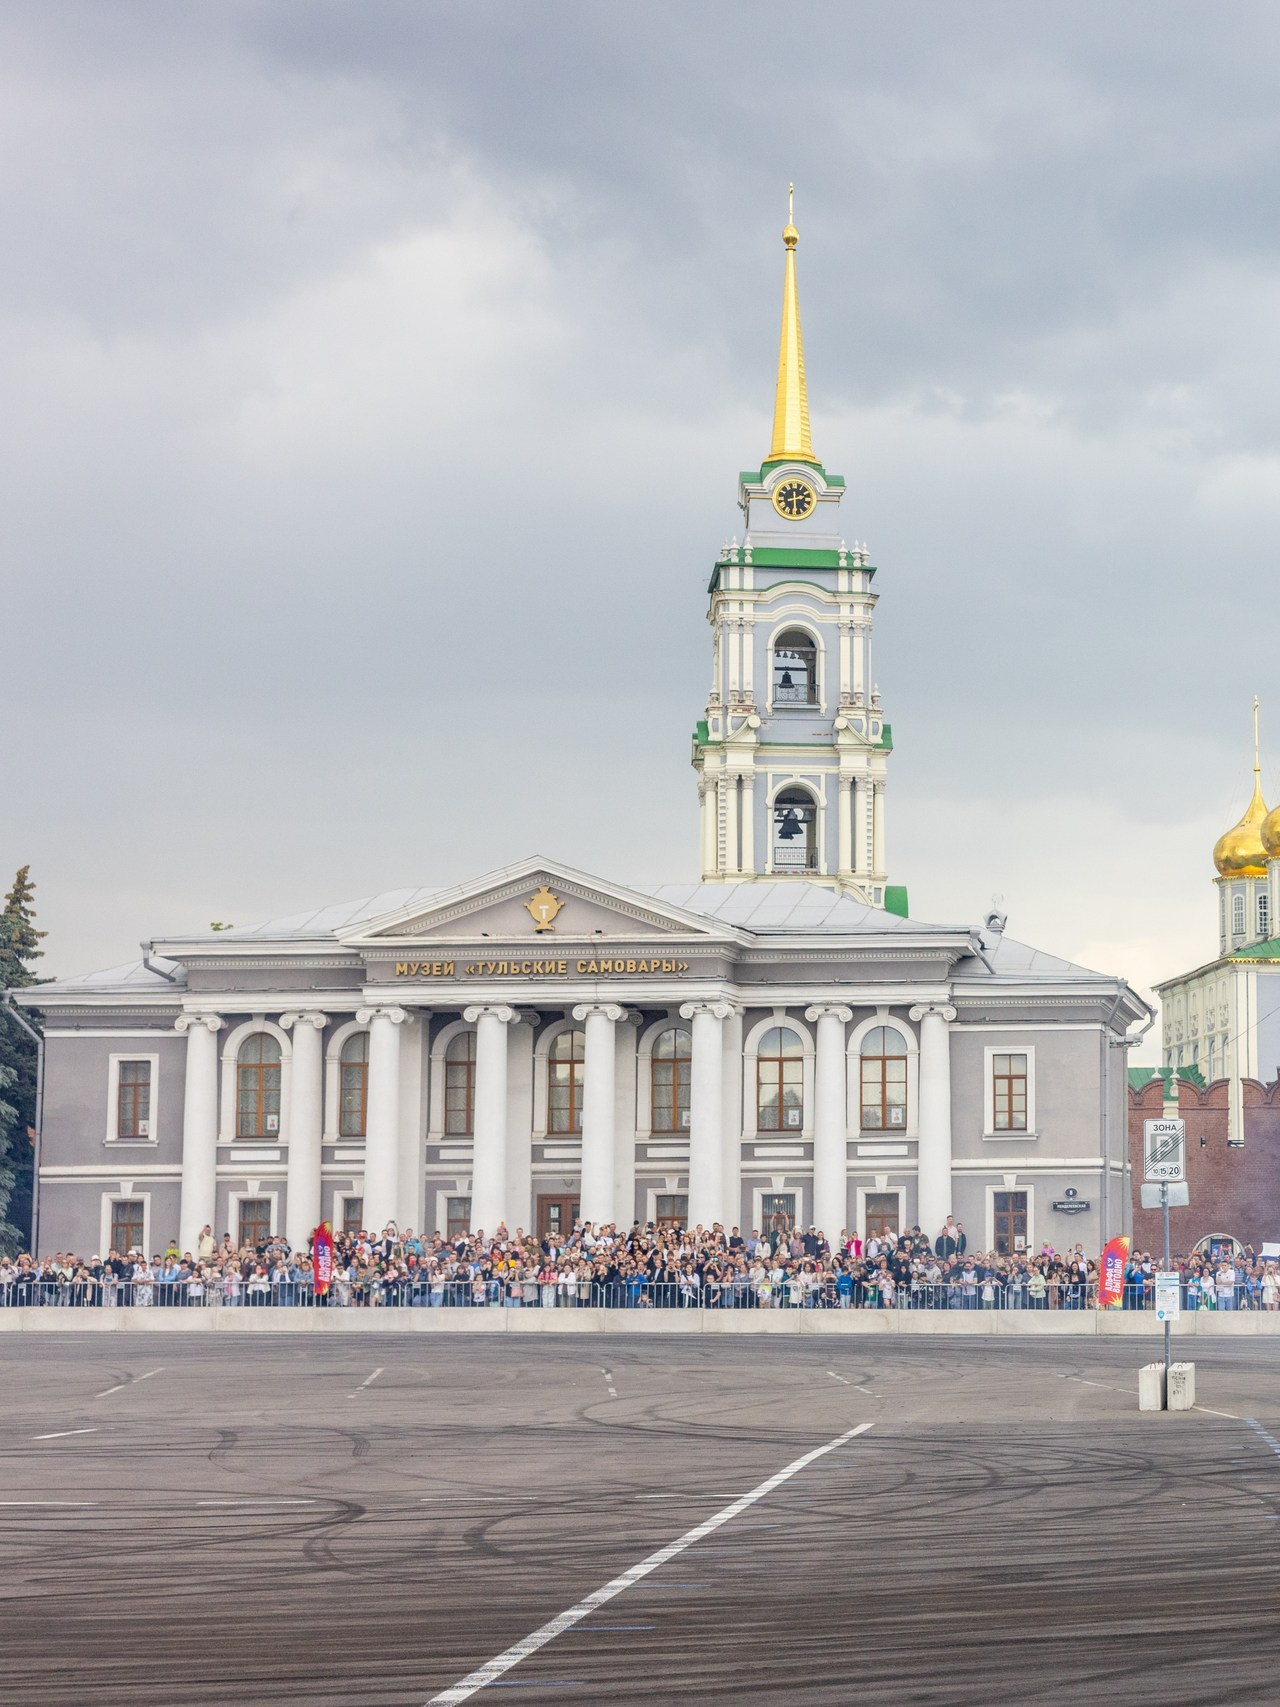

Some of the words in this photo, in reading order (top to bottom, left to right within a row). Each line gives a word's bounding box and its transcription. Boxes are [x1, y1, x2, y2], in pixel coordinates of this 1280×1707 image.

[395, 960, 455, 976] МУЗЕЙ
[464, 960, 567, 975] «ТУЛЬСКИЕ
[576, 959, 689, 974] САМОВАРЫ»
[1169, 1166, 1179, 1174] 20
[1105, 1268, 1114, 1291] АЛЬФА
[1112, 1258, 1123, 1293] ВЫГОДНО
